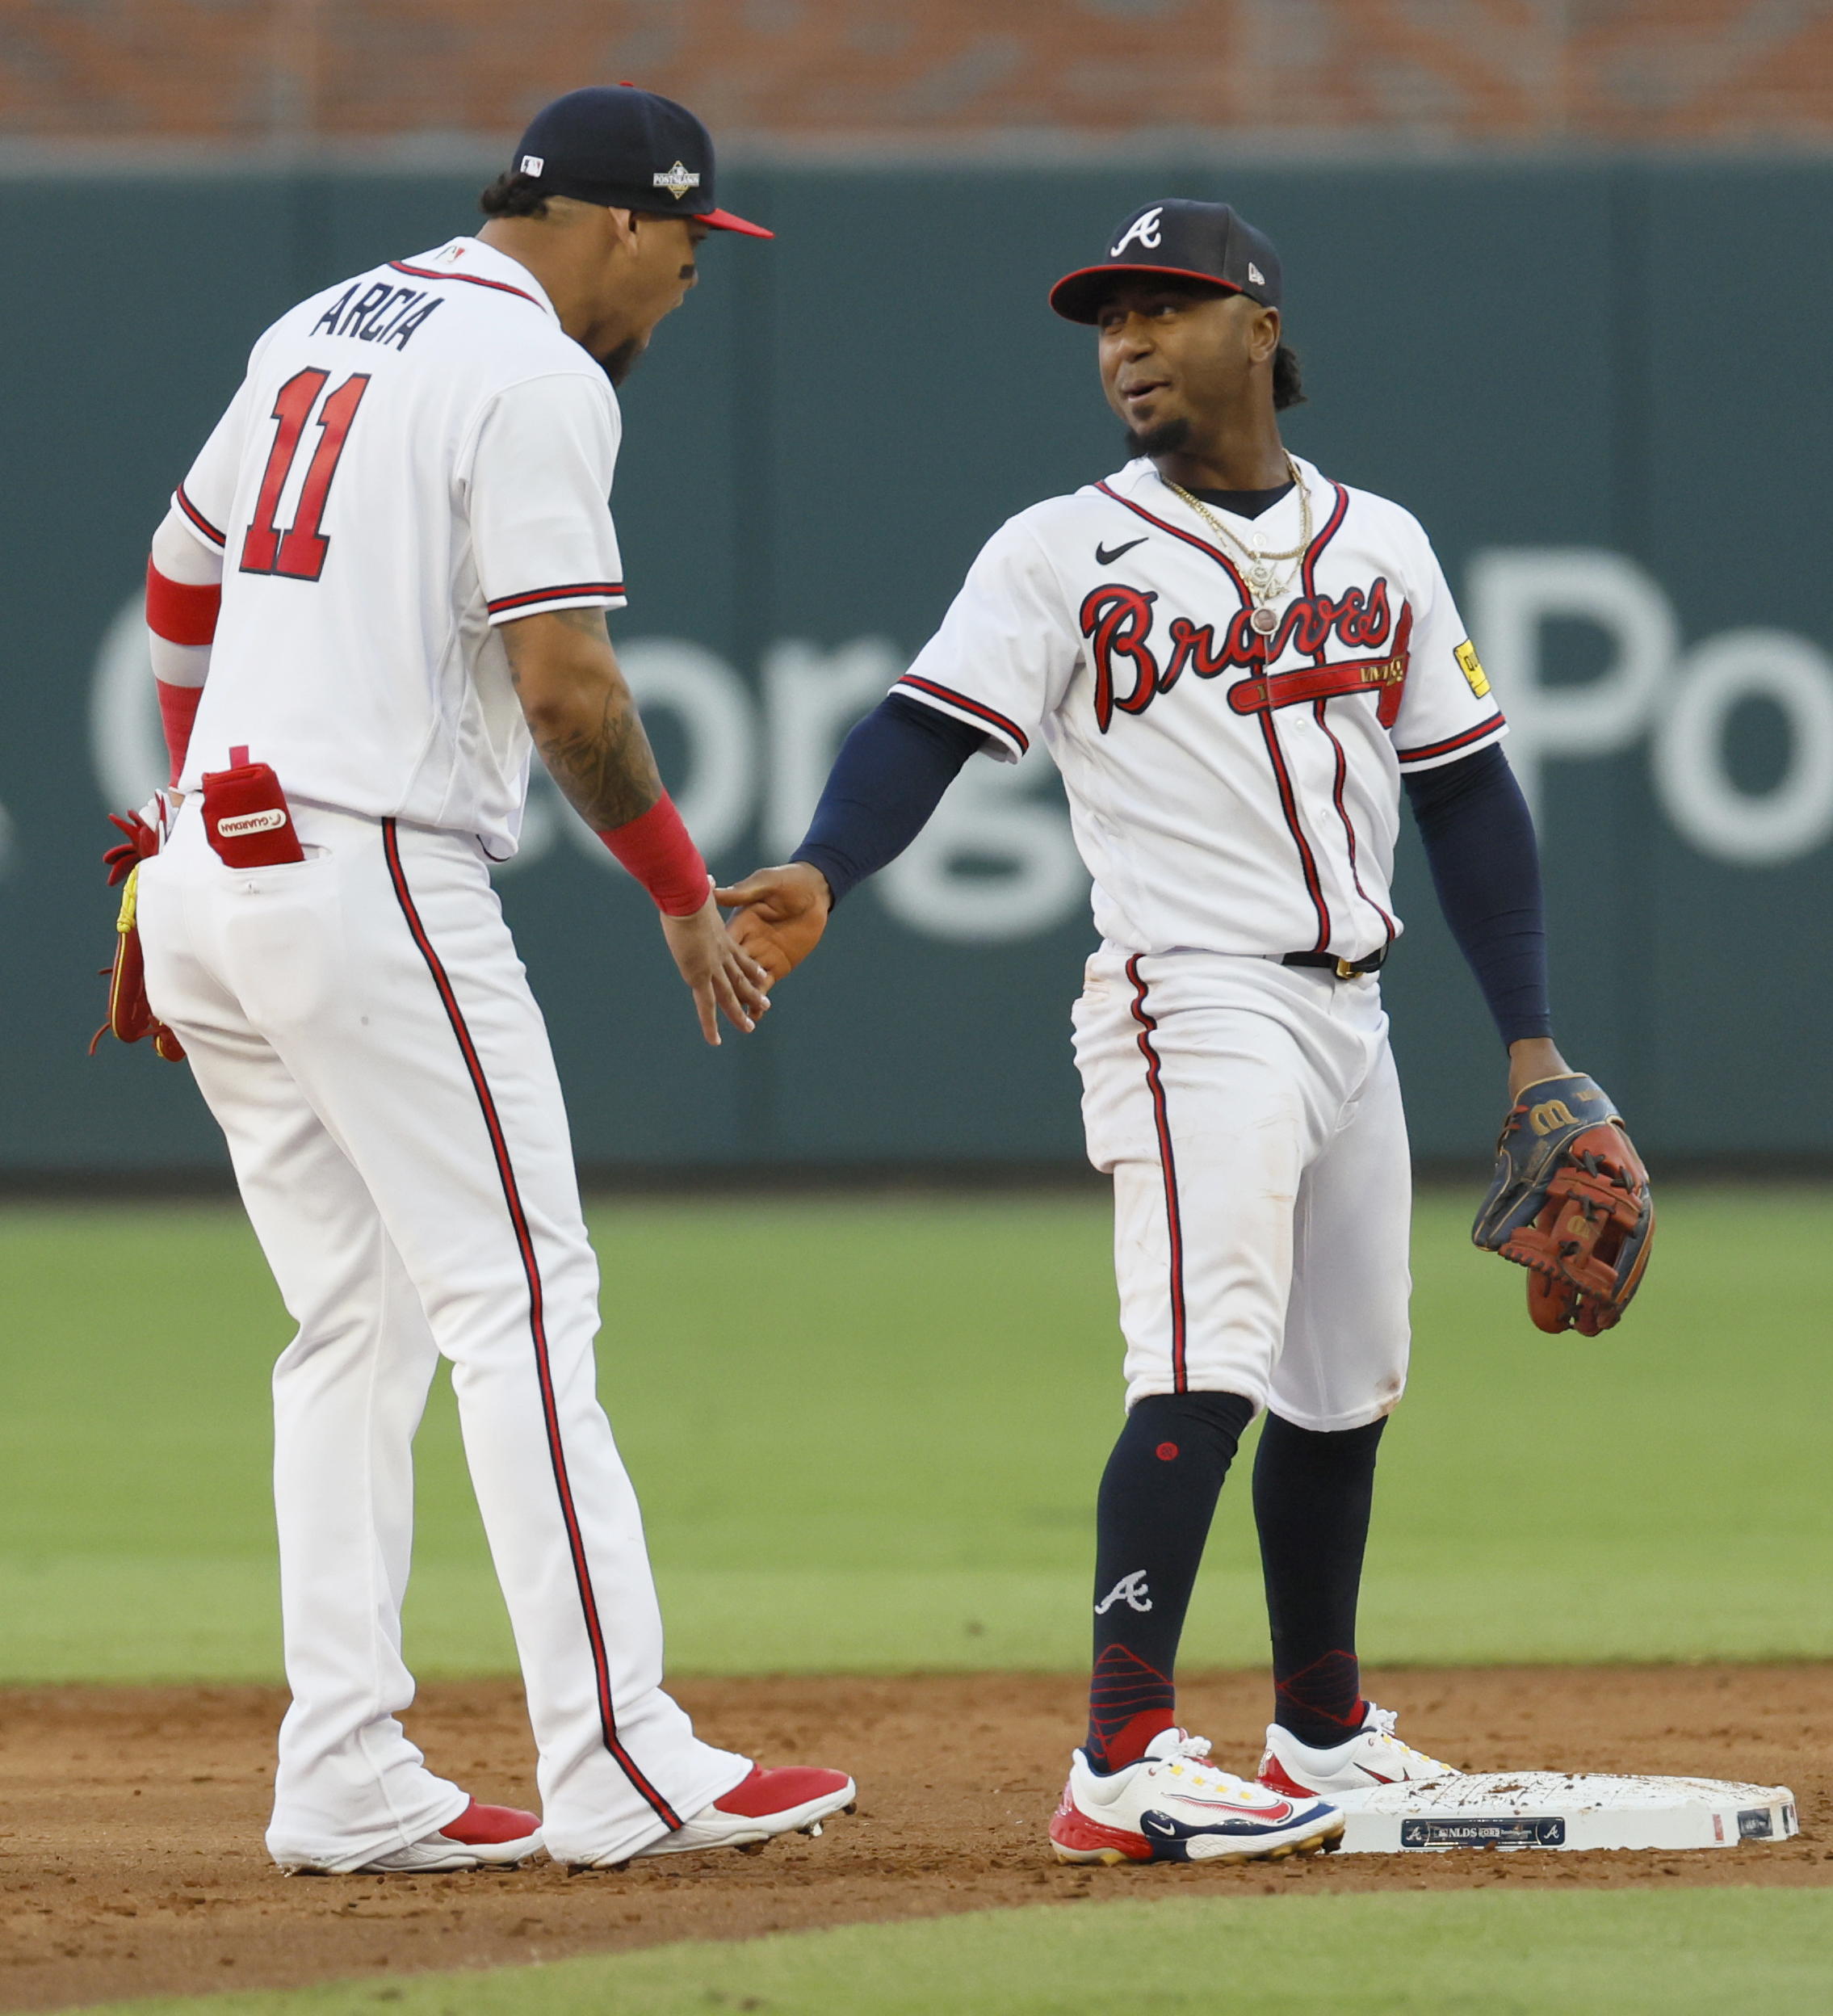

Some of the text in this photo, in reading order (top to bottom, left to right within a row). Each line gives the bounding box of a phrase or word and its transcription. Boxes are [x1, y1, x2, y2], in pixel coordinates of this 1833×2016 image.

[654, 174, 699, 186] POSTSEASON
[1110, 207, 1163, 258] A
[309, 282, 445, 351] ARCIA
[239, 367, 371, 582] 11
[1079, 578, 1391, 733] Braves
[221, 817, 269, 833] GUARDIAN
[1094, 1569, 1152, 1615] A
[1449, 1828, 1478, 1838] NLDS
